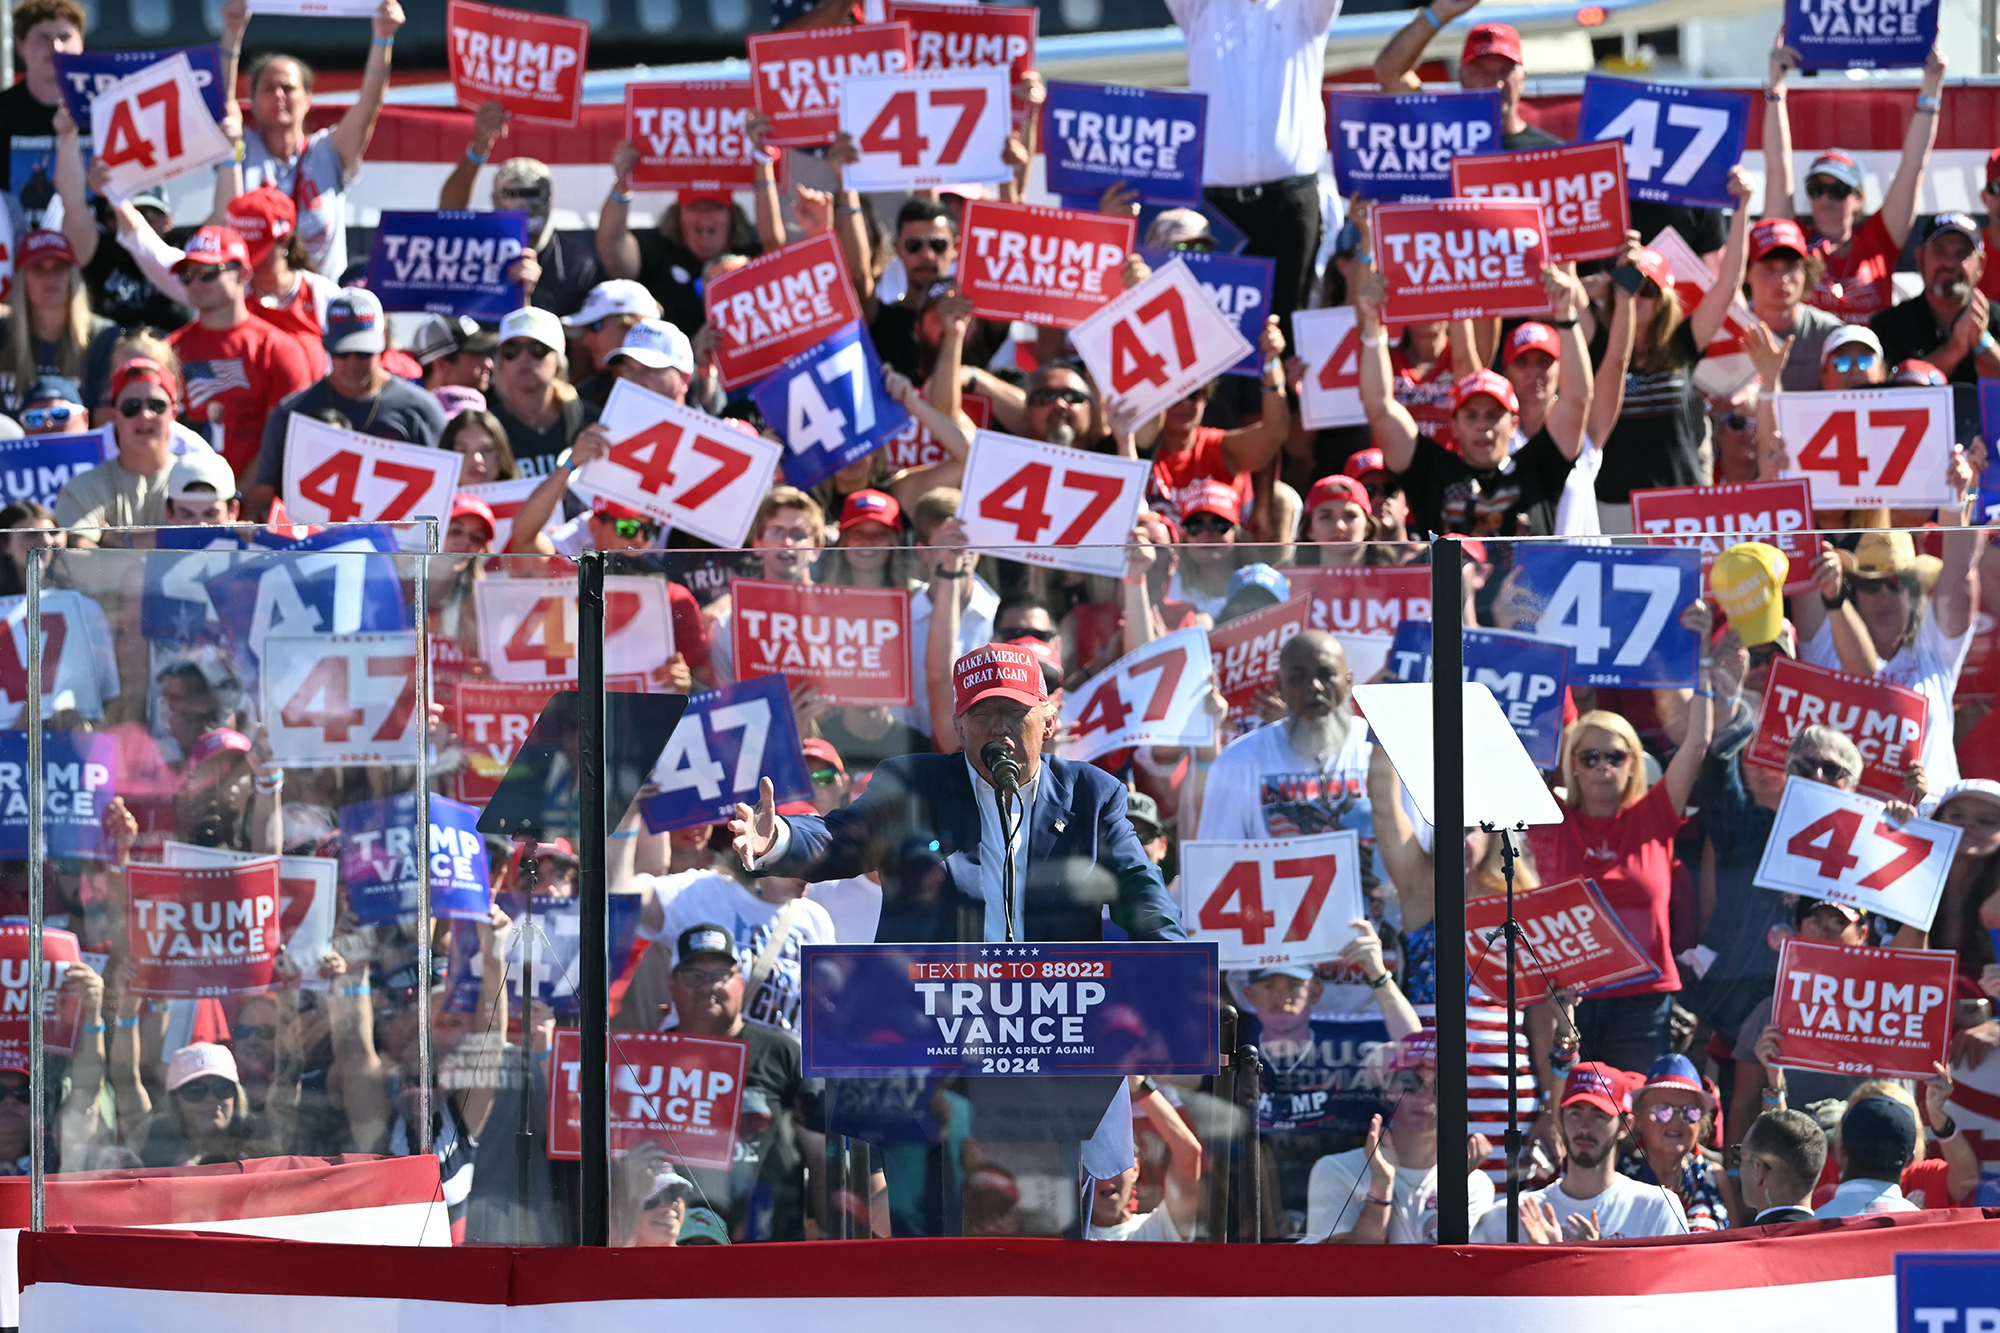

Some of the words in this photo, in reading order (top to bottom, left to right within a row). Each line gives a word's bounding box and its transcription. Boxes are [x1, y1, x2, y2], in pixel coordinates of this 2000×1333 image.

[1809, 14, 1919, 36] VANCE
[453, 28, 579, 70] TRUMP
[911, 30, 1029, 63] RUMP
[461, 56, 558, 94] VANCE
[760, 49, 907, 89] TRUMP
[101, 79, 184, 168] 47
[634, 107, 753, 135] TRUM
[860, 88, 987, 167] 47
[1053, 110, 1196, 147] TRUMP
[1340, 120, 1491, 150] TRUMP
[1064, 136, 1178, 171] VANCE
[1594, 98, 1730, 187] 47
[382, 235, 521, 264] TRUMP
[971, 227, 1124, 270] TRUMP
[1384, 227, 1540, 264] TRUMP
[393, 258, 501, 283] VANCE
[984, 254, 1103, 292] VANCE
[1403, 254, 1526, 284] VANCE
[710, 262, 838, 331] TRUMP
[727, 292, 834, 345] VANCE
[1111, 286, 1197, 394] 47
[788, 340, 876, 455] 47
[609, 420, 752, 510] 47
[1797, 408, 1929, 486] 47
[300, 450, 436, 528] 47
[980, 461, 1125, 545] 47
[741, 609, 899, 645] TRUMP
[1311, 599, 1431, 628] RUMP
[1537, 561, 1681, 666] 47
[759, 639, 882, 669] VANCE
[957, 653, 984, 676] MAKE
[984, 650, 1033, 668] AMERICA
[962, 669, 994, 690] GREAT
[995, 667, 1028, 684] AGAIN
[1069, 647, 1187, 738] 47
[281, 655, 418, 744] 47
[1774, 684, 1920, 744] TRUMP
[652, 698, 771, 801] 47
[1784, 714, 1903, 767] VCE
[352, 824, 480, 861] TRMP
[1787, 807, 1933, 891] 47
[372, 856, 475, 882] VACE
[134, 895, 274, 932] TRUMP
[1198, 854, 1337, 946] 47
[147, 928, 265, 957] VANCE
[916, 963, 968, 978] TEXT
[973, 963, 1003, 978] NC
[1008, 962, 1034, 977] TO
[1041, 962, 1104, 977] 88022
[914, 982, 1106, 1015] TRUMP
[1788, 971, 1944, 1015] TRUMP
[936, 1016, 1084, 1043] VANCE
[1787, 1027, 1812, 1039] MAKE
[1815, 1030, 1858, 1043] AMERICA
[1861, 1036, 1894, 1046] GREAT
[1897, 1038, 1930, 1050] AGAIN!
[1798, 1003, 1924, 1039] VANCE
[927, 1047, 958, 1055] MAKE
[962, 1047, 1012, 1055] AMERICA
[1015, 1046, 1052, 1055] GREAT
[1056, 1046, 1095, 1054] AGAIN!
[981, 1058, 1040, 1073] 2024
[1837, 1061, 1873, 1074] 2024
[561, 1061, 734, 1101] TUMP
